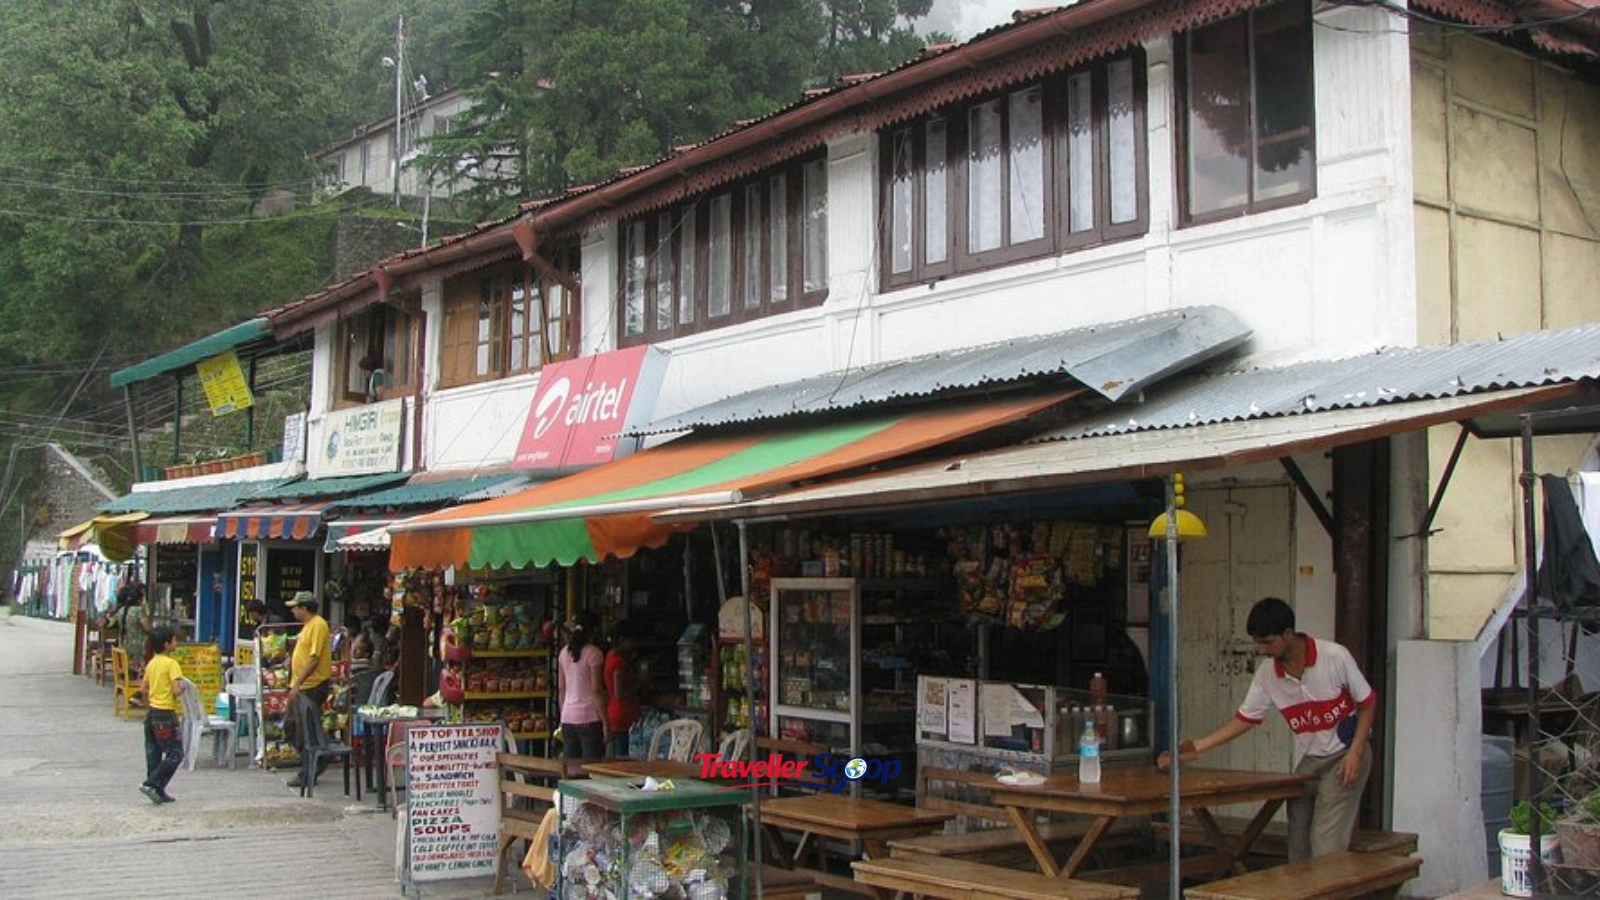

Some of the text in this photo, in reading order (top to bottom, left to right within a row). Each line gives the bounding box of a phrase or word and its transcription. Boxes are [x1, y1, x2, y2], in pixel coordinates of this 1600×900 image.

[565, 378, 626, 426] airtel
[410, 726, 500, 739] TIP TOP TEA SHOP
[410, 741, 417, 752] A
[419, 740, 451, 753] PERFECT
[425, 771, 475, 781] SANDWICH
[412, 807, 460, 817] PAN CAKES
[412, 815, 463, 826] PIZZA
[413, 824, 471, 835] SOUPS
[413, 844, 434, 854] COLD
[435, 842, 465, 852] COFFEE
